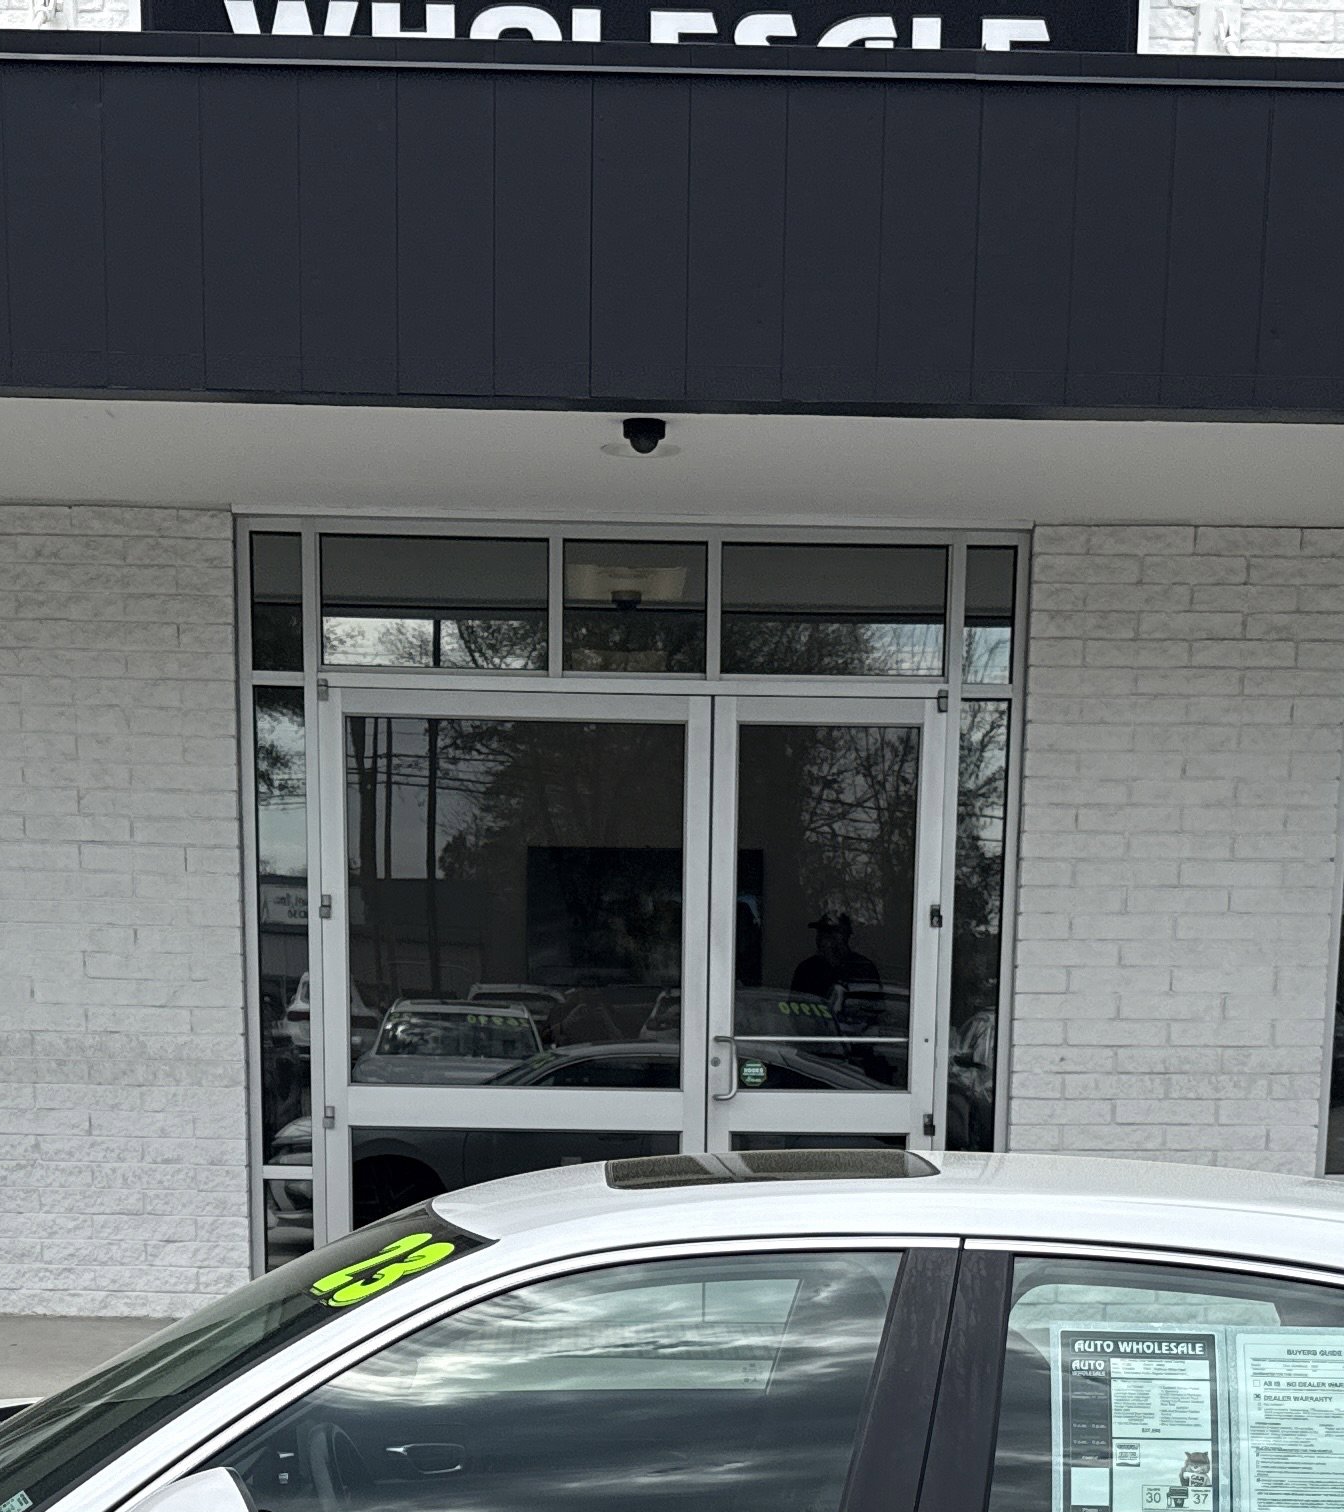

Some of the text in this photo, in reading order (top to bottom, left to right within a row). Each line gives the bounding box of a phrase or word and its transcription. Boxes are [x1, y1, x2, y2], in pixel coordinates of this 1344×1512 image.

[1074, 1340, 1204, 1355] AUTO WHOLESALE
[1072, 1359, 1105, 1370] AUTO
[1145, 1492, 1162, 1504] 30
[1192, 1494, 1209, 1505] 37
